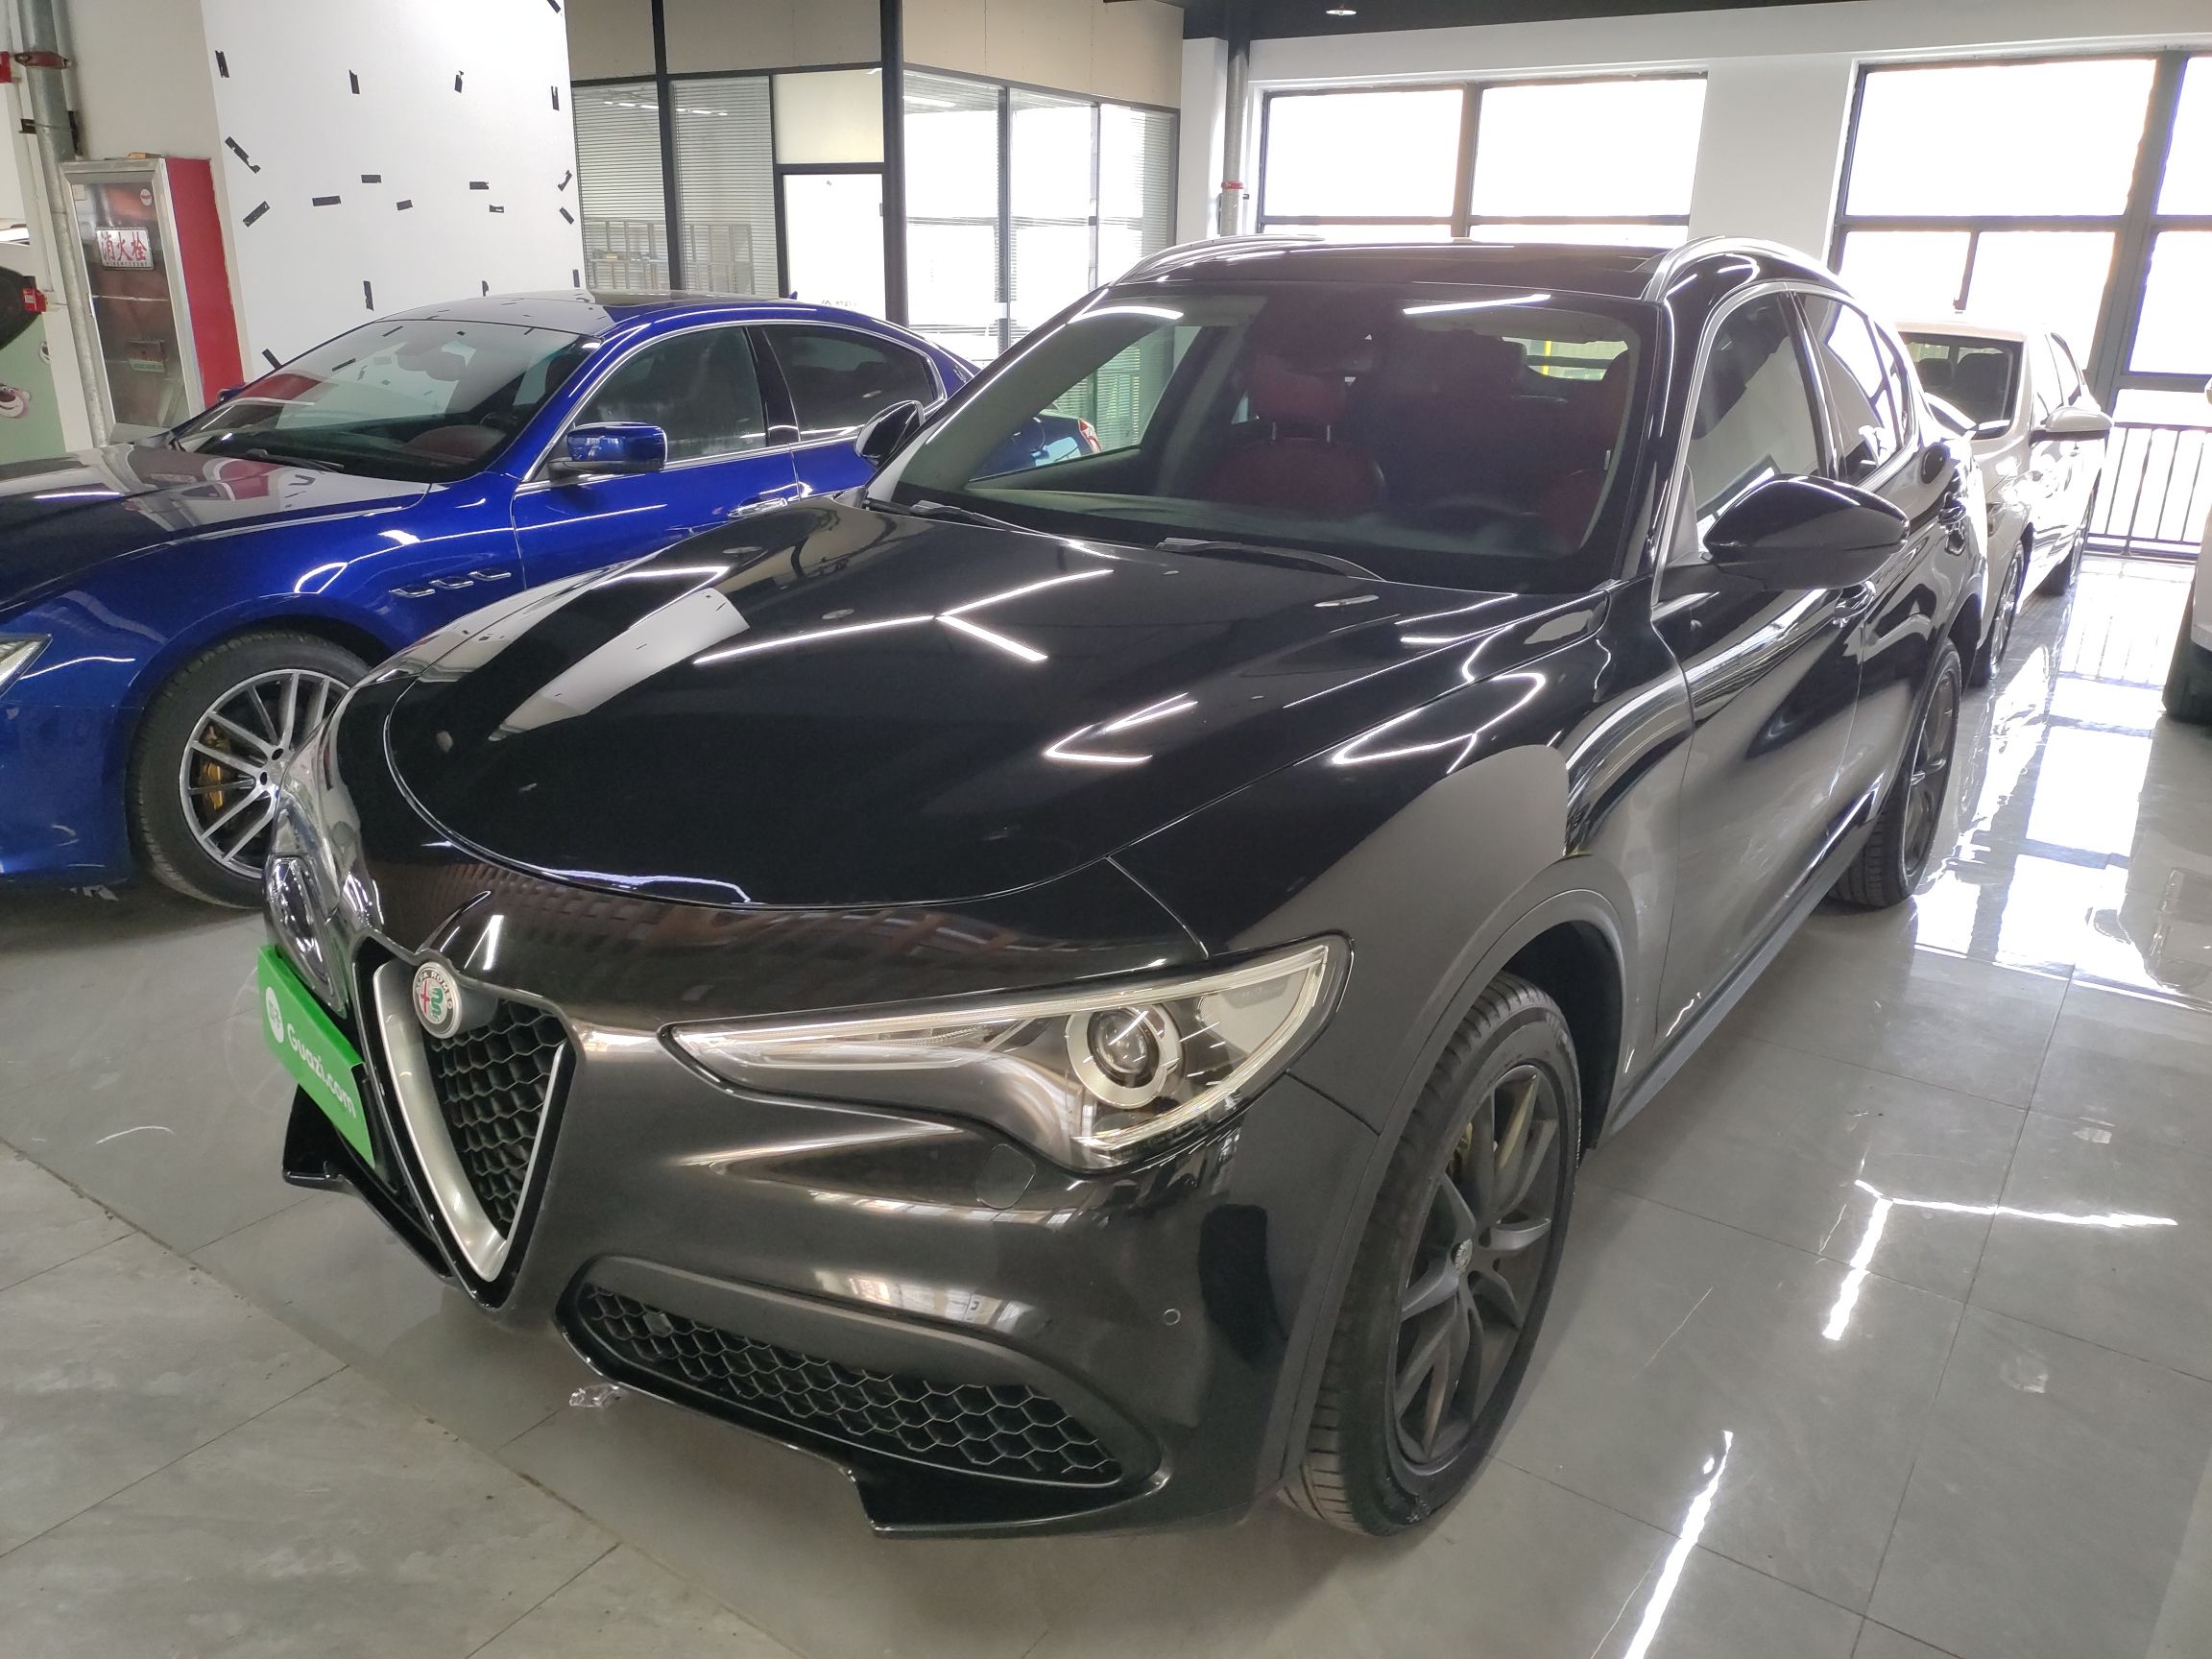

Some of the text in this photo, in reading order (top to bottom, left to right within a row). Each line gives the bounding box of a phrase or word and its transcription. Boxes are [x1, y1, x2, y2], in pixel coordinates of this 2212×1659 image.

[102, 231, 147, 261] 消火栓
[431, 972, 453, 1009] ROMEO
[288, 1022, 356, 1118] Guazi.com
